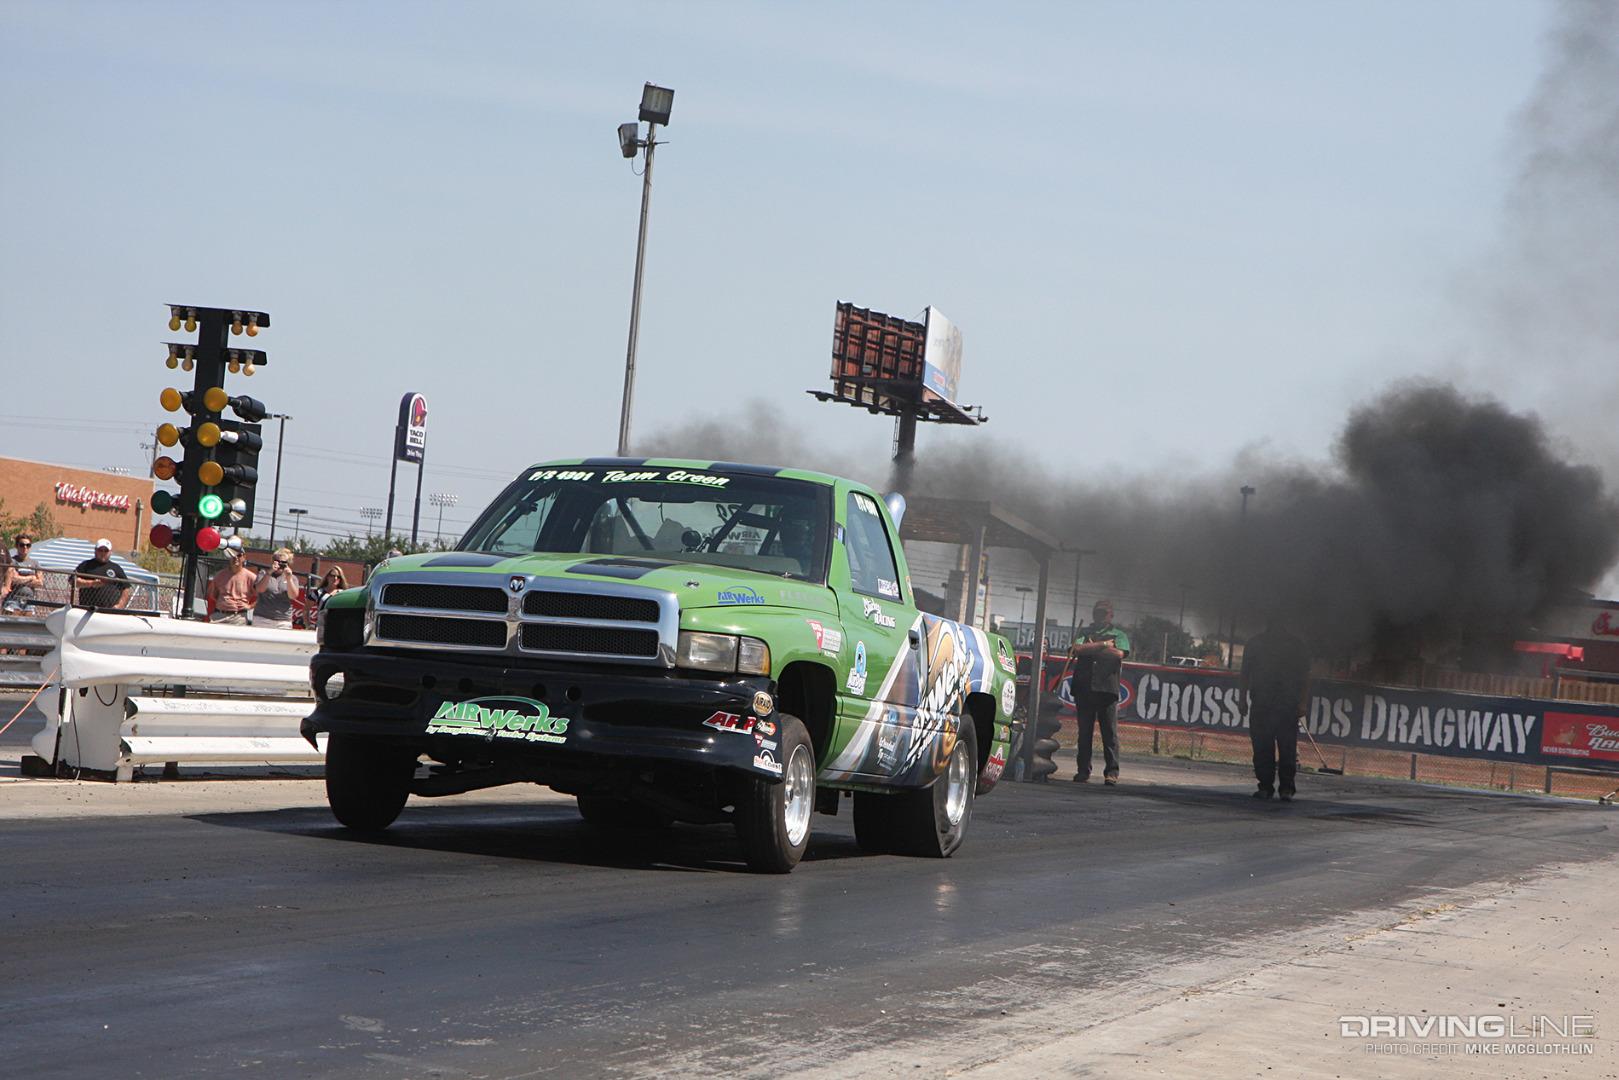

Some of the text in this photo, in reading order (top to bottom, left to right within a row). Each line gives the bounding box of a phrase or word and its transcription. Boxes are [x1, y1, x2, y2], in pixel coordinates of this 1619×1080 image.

[410, 429, 424, 438] TACO
[410, 437, 423, 446] BELL
[602, 470, 660, 482] Team
[666, 470, 730, 486] Green
[55, 482, 131, 509] Walgreens
[429, 697, 570, 734] AIRWerks
[1137, 674, 1352, 738] CROSSDS
[1361, 695, 1536, 753] DRAGWAY
[497, 730, 525, 739] Turbo
[525, 732, 567, 743] Systems
